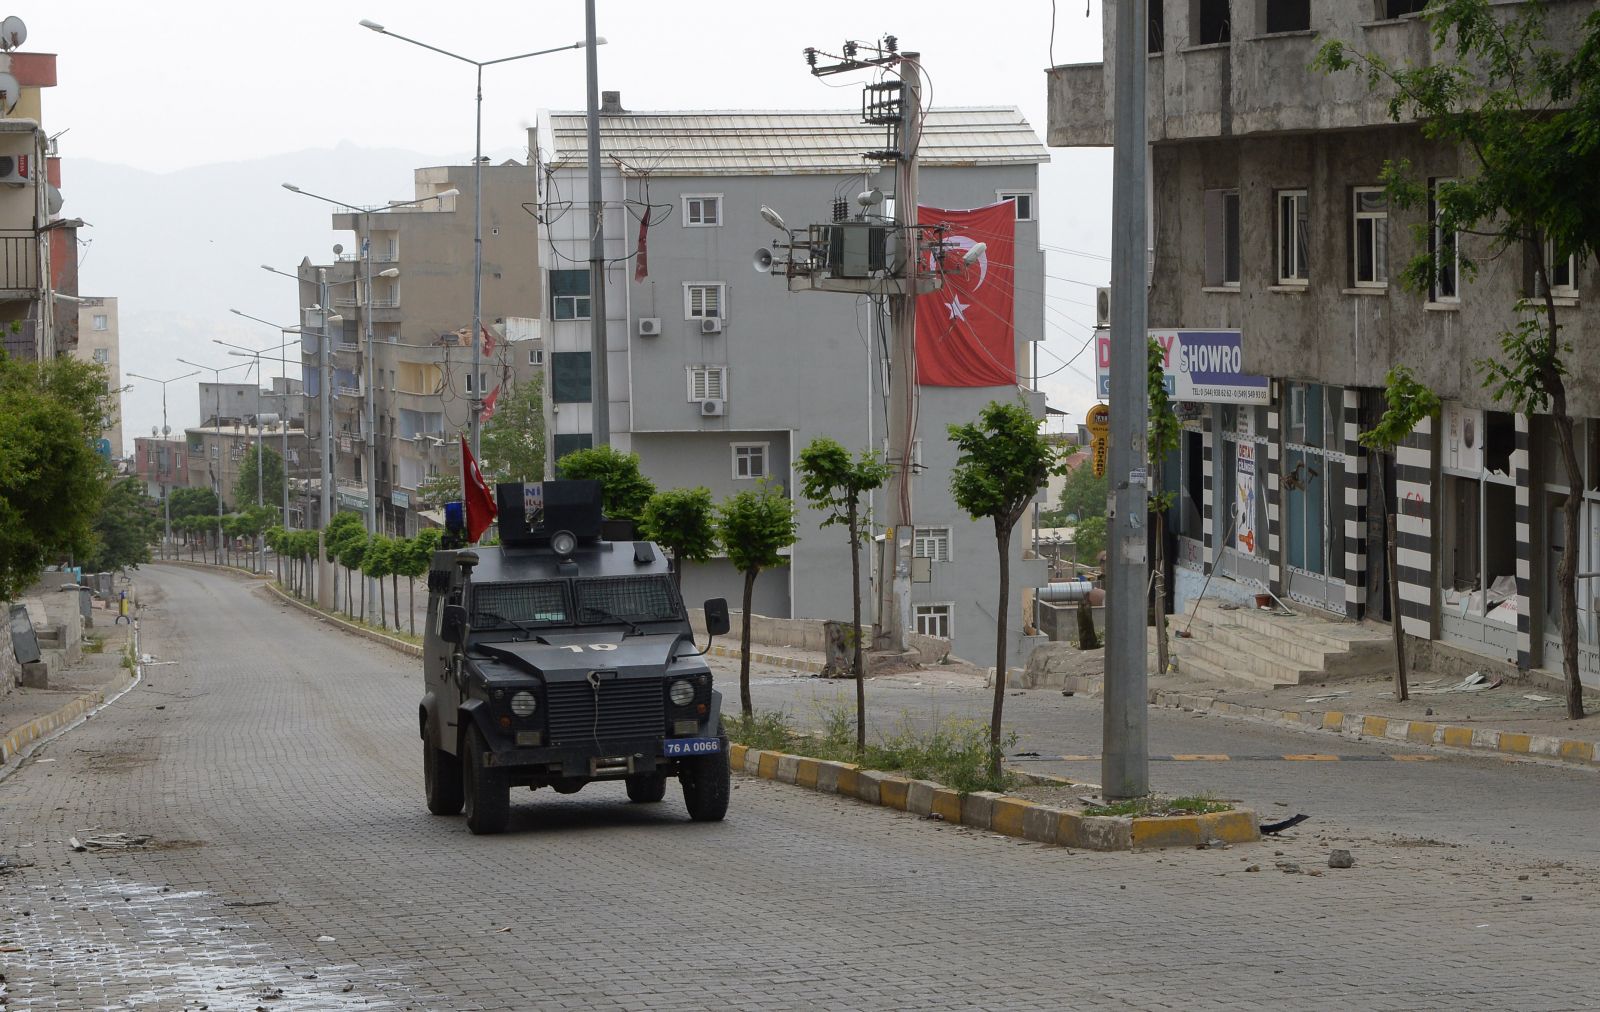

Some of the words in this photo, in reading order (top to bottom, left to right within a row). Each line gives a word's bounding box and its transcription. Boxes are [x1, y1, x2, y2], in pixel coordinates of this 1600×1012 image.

[1180, 344, 1242, 374] SHOWRO
[667, 743, 681, 754] 76
[683, 743, 691, 752] A
[693, 741, 718, 752] 0066
